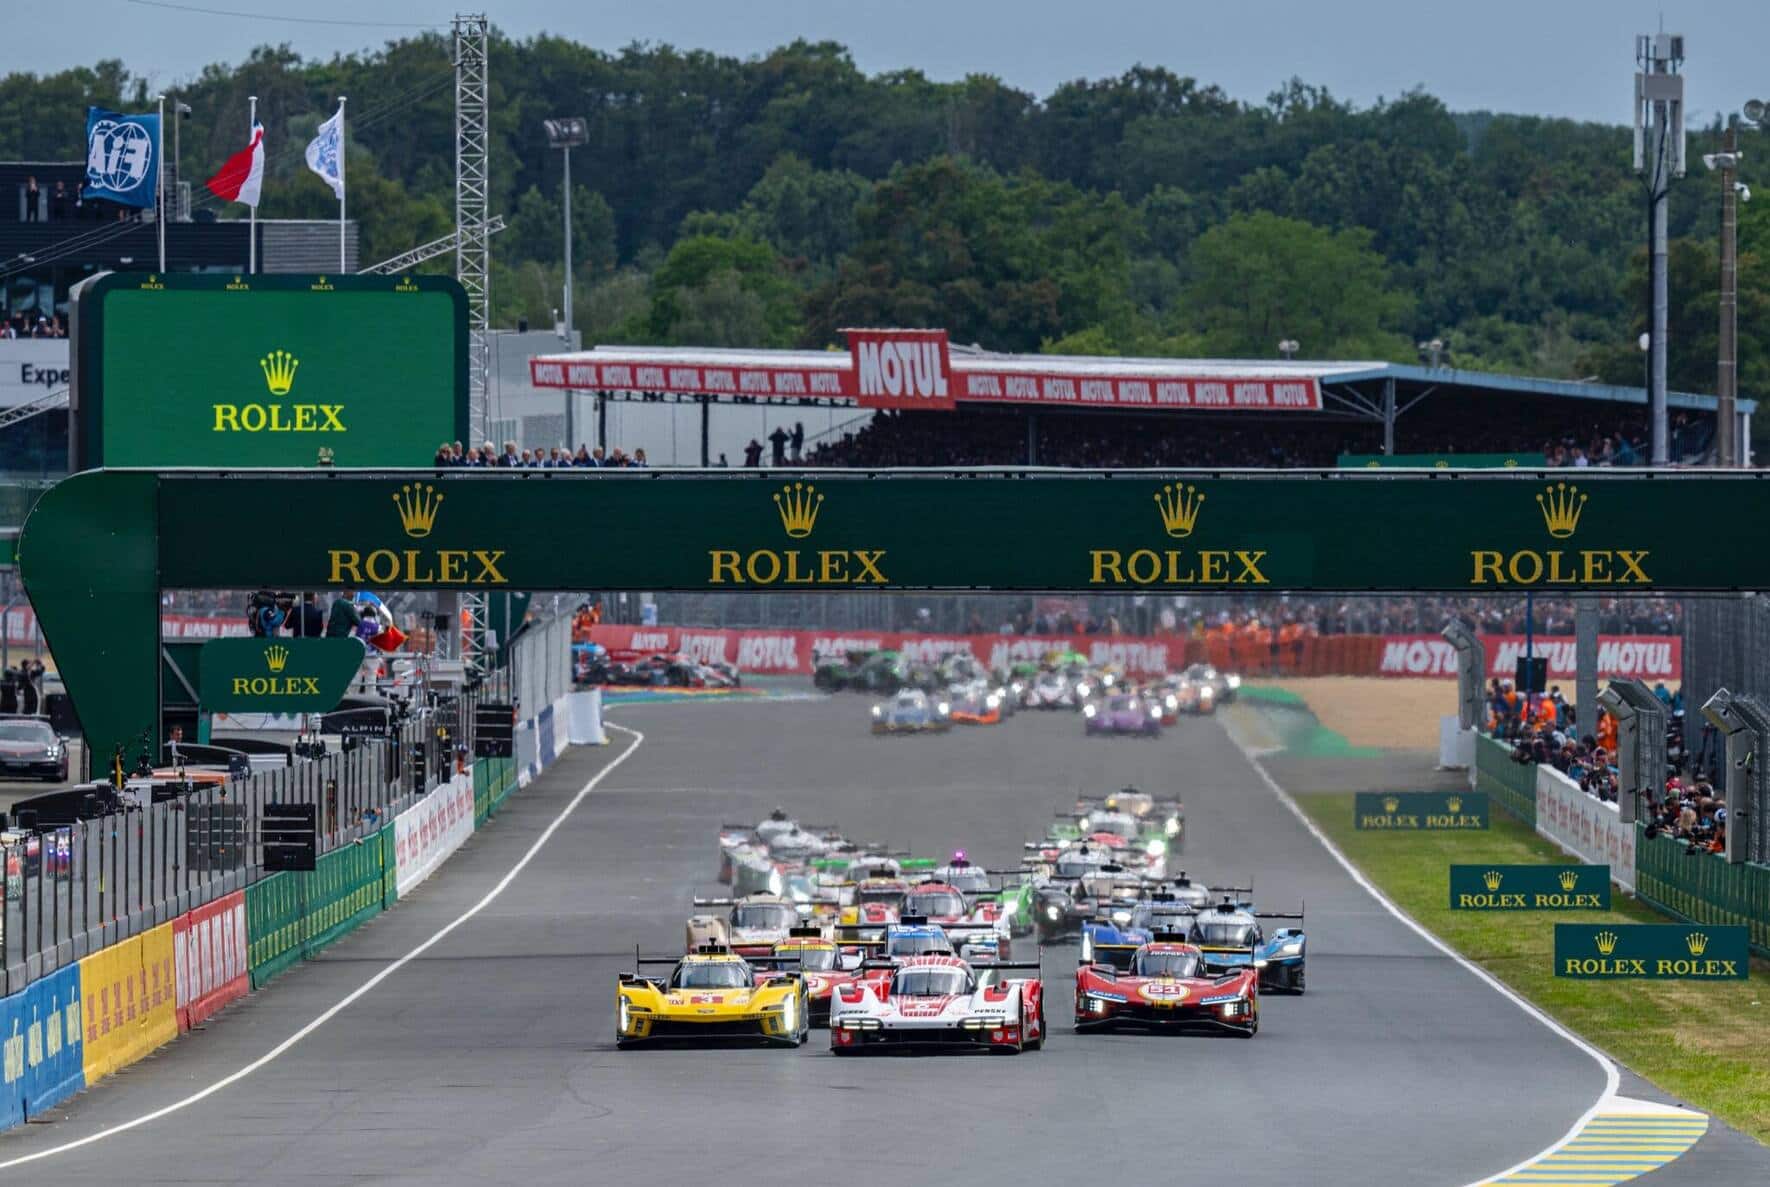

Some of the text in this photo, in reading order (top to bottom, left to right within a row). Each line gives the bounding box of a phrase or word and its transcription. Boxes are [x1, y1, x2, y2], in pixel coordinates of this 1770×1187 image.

[535, 363, 841, 394] MOTUL MOTUL MOTUL MOTUL MOTUL MOTUL MOTUL MOTUL MOTUL
[858, 341, 948, 397] MOTUL
[967, 375, 1309, 405] MOTUL MOTUL MOTUL MOTUL MOTUL MOTUL MOTUL MOTUL MOTUL
[212, 404, 347, 433] ROLEX
[328, 549, 508, 584] ROLEX
[709, 549, 889, 584] ROLEX
[1090, 549, 1269, 584] ROLEX
[1471, 550, 1652, 584] ROLEX
[737, 636, 798, 669] MOTUL
[1381, 640, 1459, 673] MOTU
[1597, 642, 1672, 674] MOTUL
[232, 678, 320, 695] ROLEX
[1362, 815, 1481, 827] ROLEX ROLEX
[1459, 893, 1601, 908] ROLEX ROLEX
[1565, 958, 1738, 977] ROLEX ROLEX
